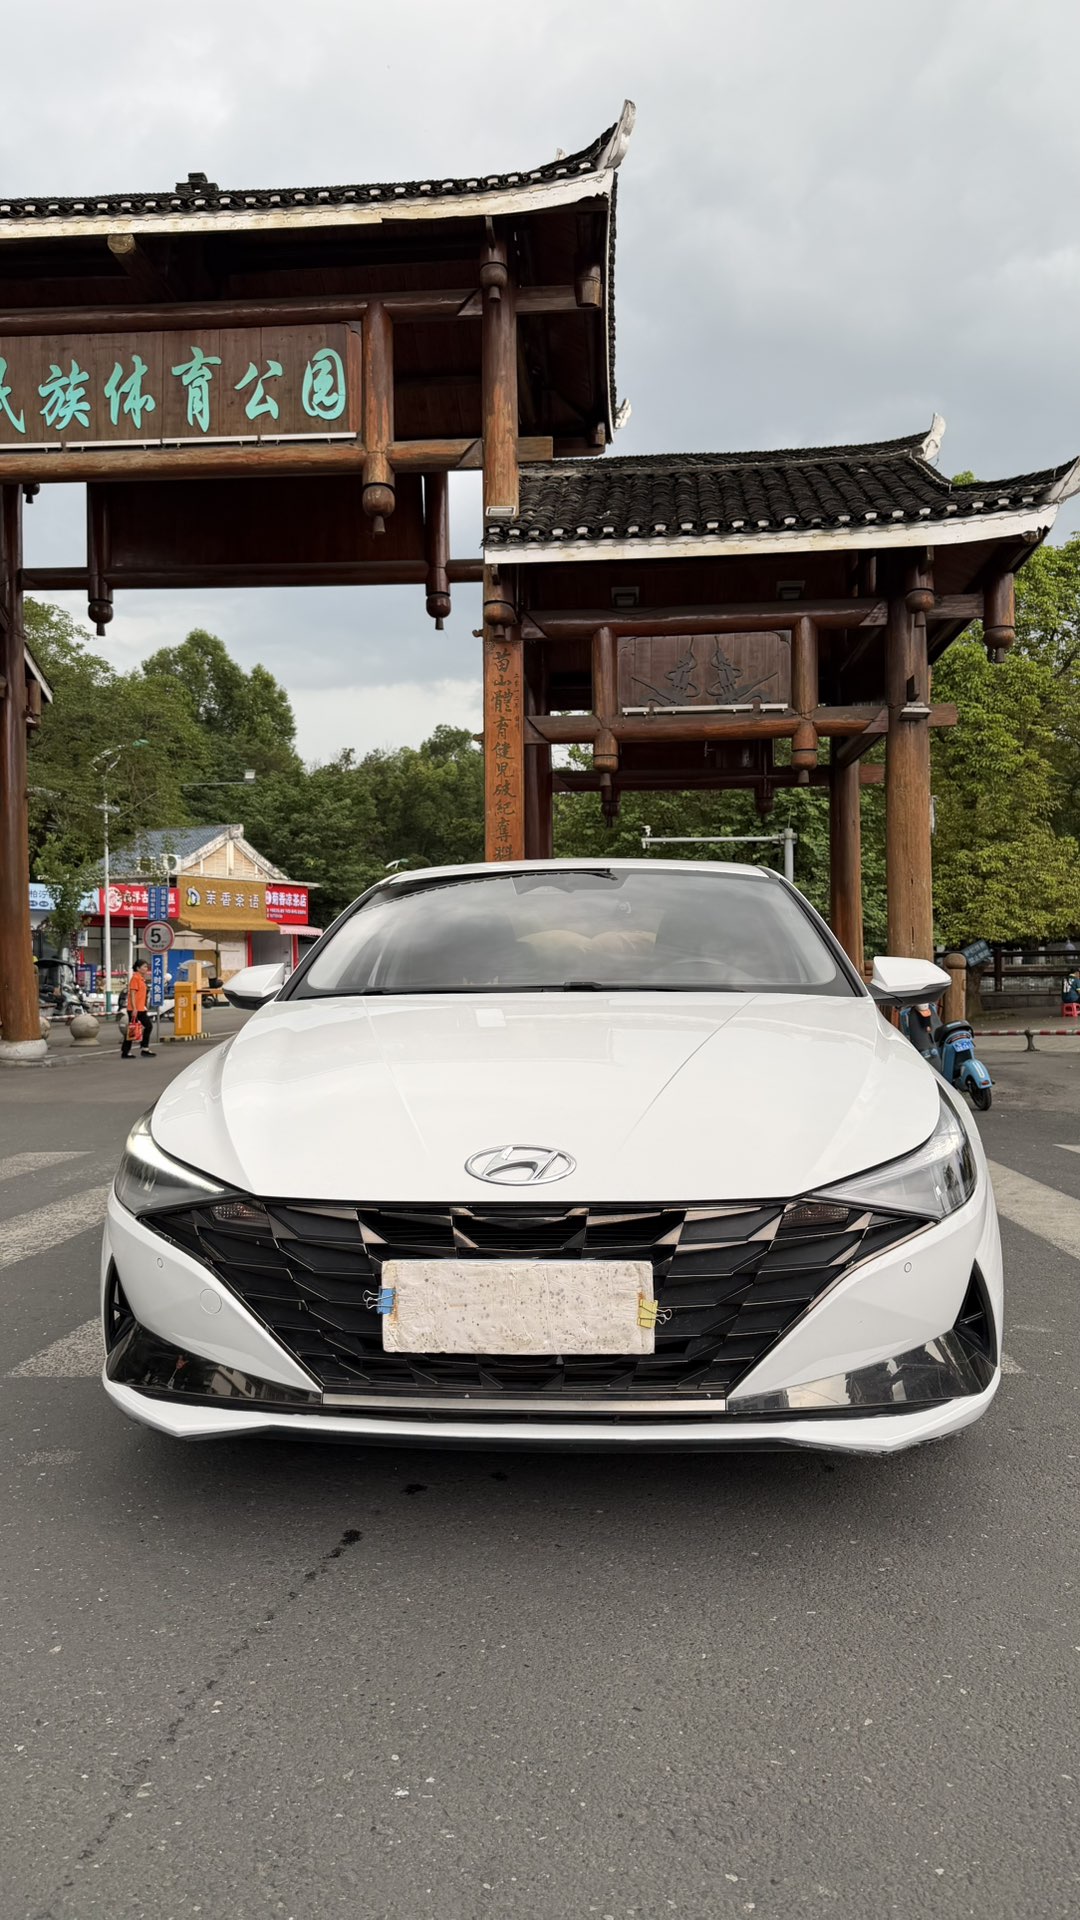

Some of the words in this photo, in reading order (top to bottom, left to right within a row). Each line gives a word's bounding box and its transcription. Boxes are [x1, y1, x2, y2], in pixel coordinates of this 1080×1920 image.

[206, 890, 259, 908] 茉香茶语
[150, 928, 161, 944] 5
[153, 957, 162, 1003] 2小时免费
